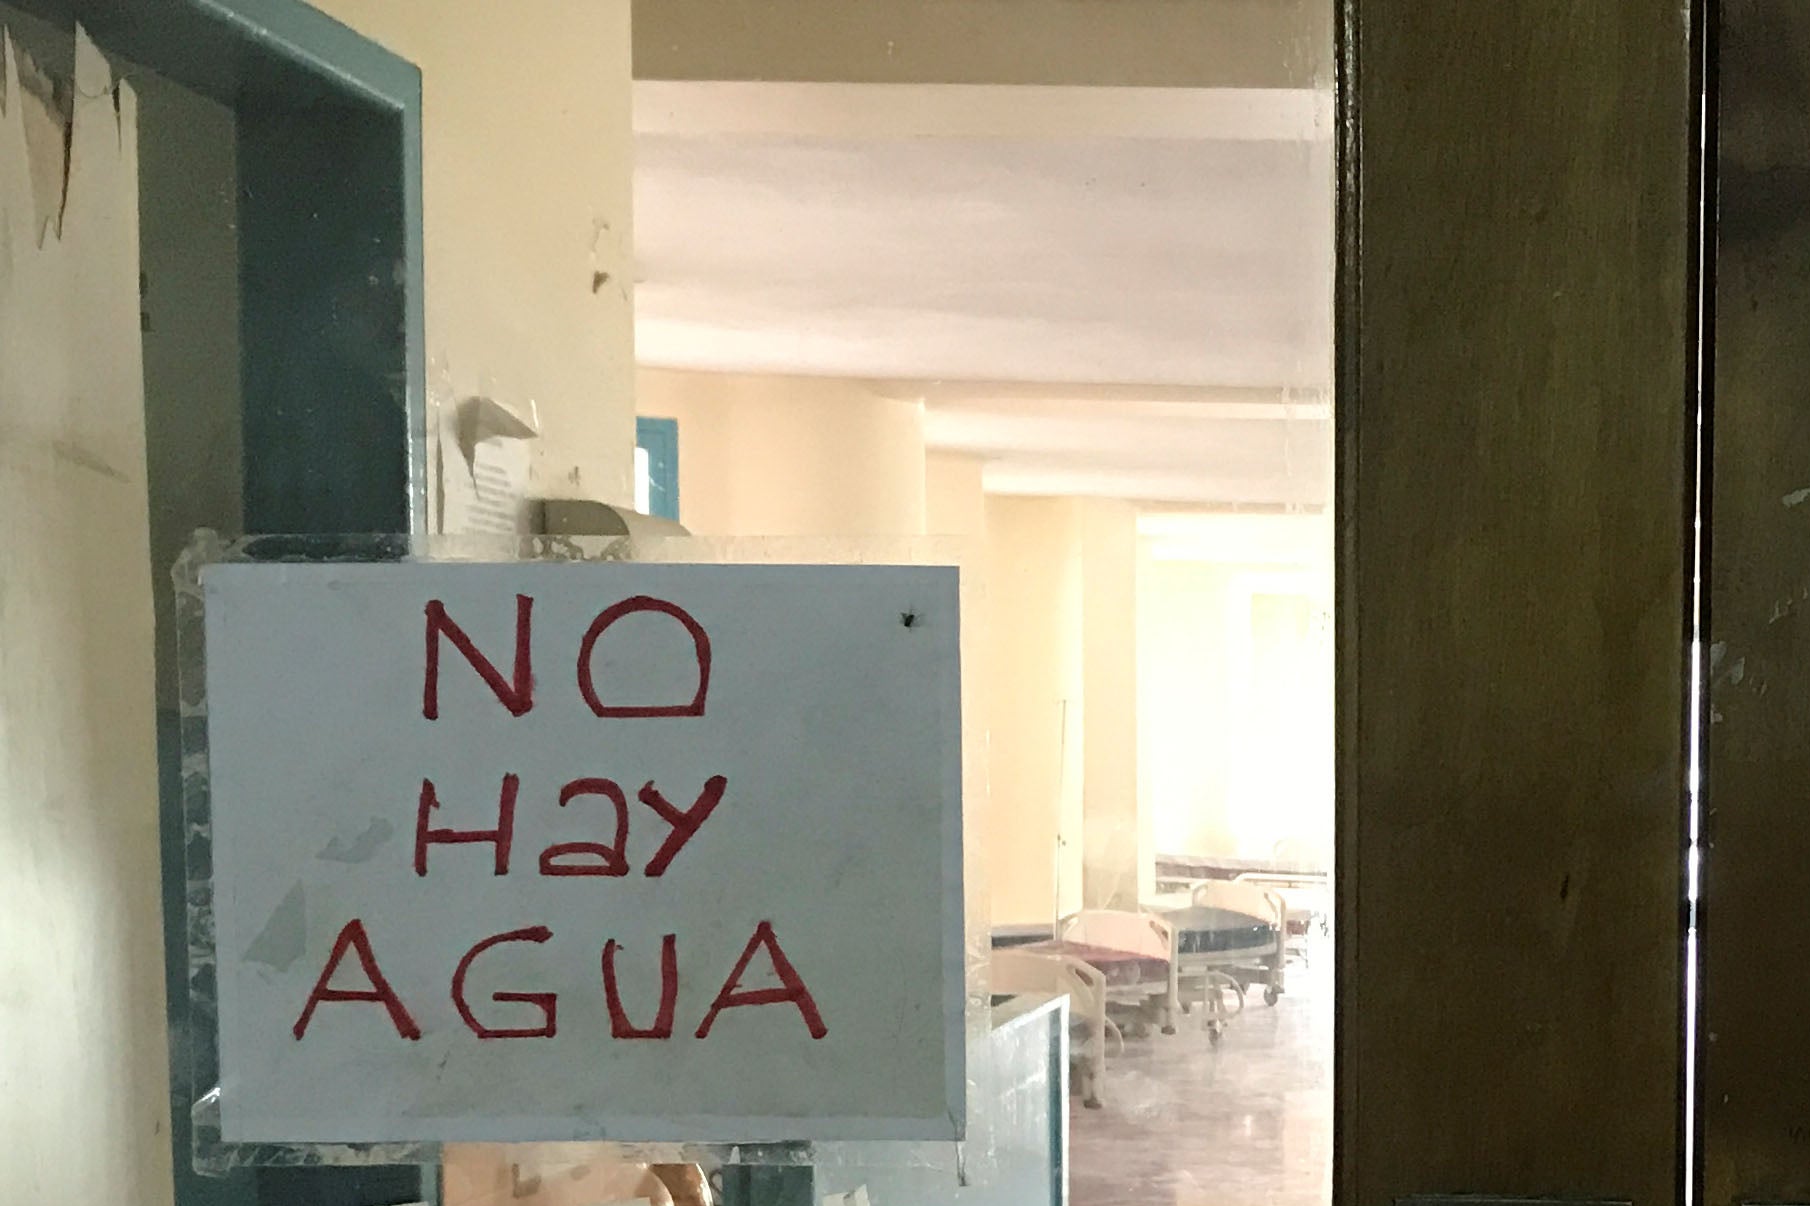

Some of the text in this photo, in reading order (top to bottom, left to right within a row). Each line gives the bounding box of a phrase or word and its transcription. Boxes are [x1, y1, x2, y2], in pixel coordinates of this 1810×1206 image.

[422, 592, 713, 722] NO
[413, 772, 729, 879] Hay
[292, 917, 829, 1042] AGUA
